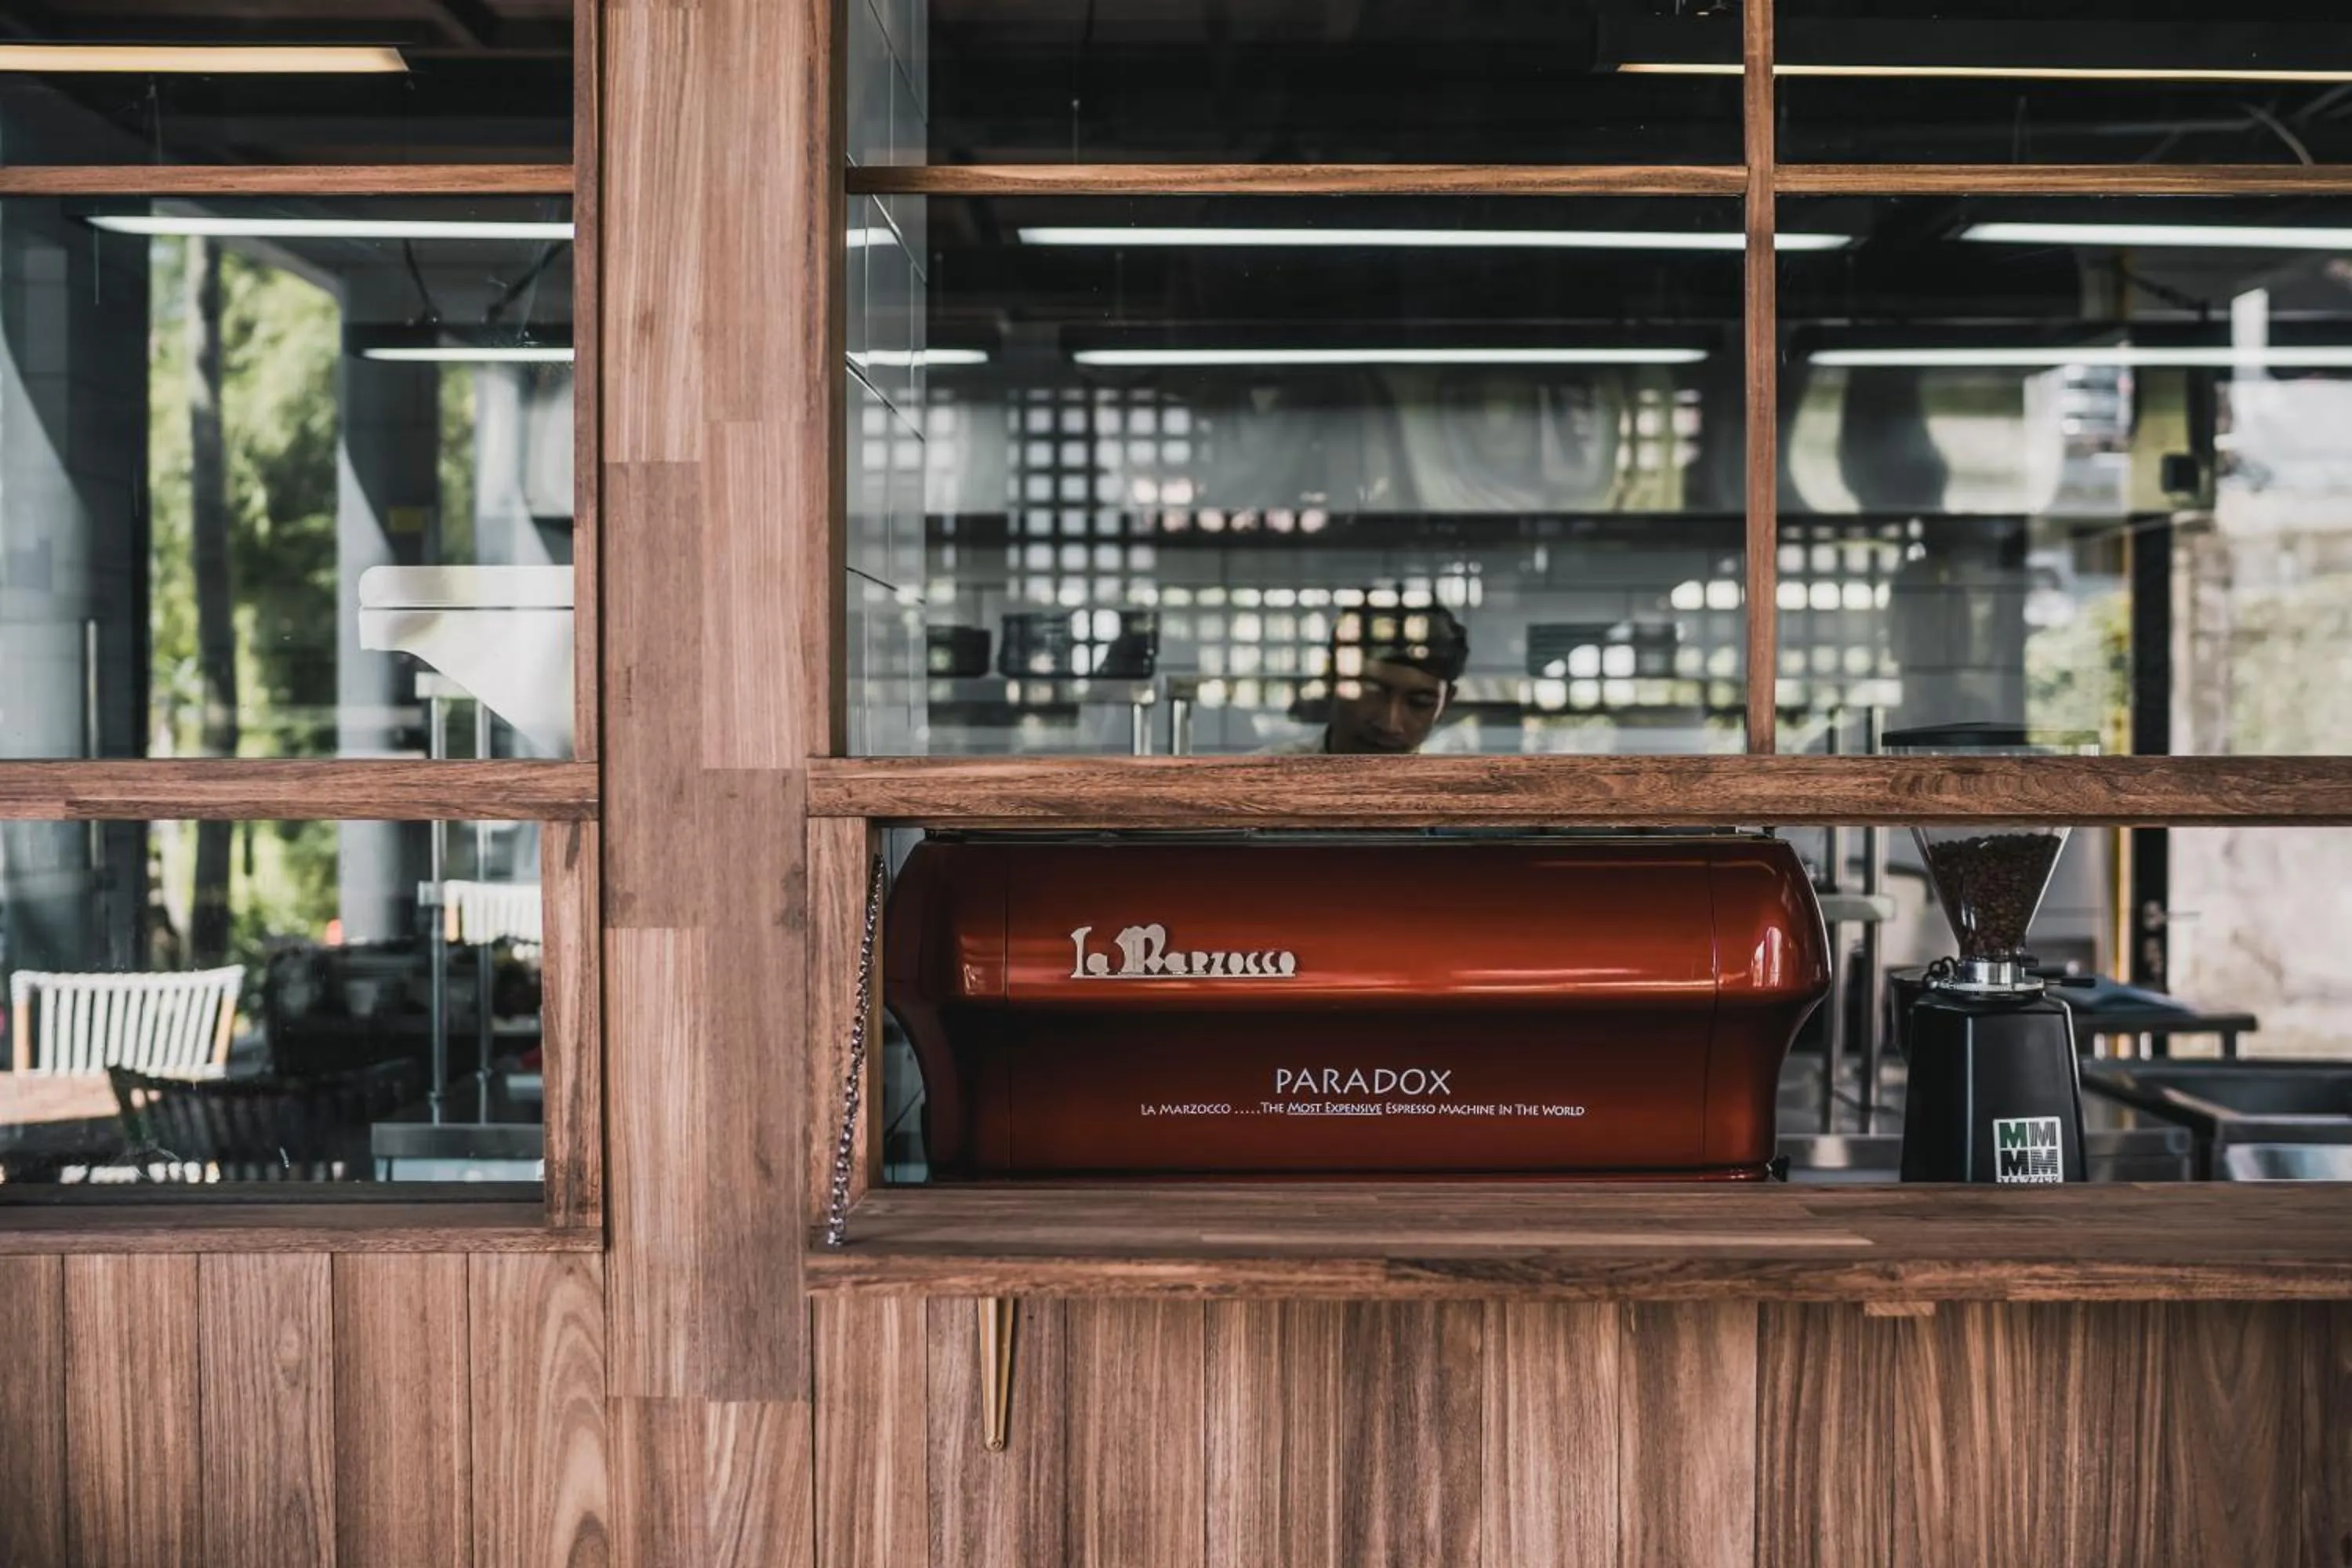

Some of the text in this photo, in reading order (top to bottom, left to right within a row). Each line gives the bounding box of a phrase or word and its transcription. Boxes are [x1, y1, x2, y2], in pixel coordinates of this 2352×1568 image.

[1276, 1067, 1451, 1095] PARADOX
[1160, 1103, 1232, 1115] MARZOCCO
[1287, 1102, 1323, 1114] MOST
[1325, 1102, 1382, 1115] EXPENSIVE
[1385, 1102, 1436, 1114] ESPRESSO
[1439, 1103, 1495, 1115] MACHINE
[1515, 1104, 1539, 1116] THE
[1542, 1104, 1585, 1116] WORLD
